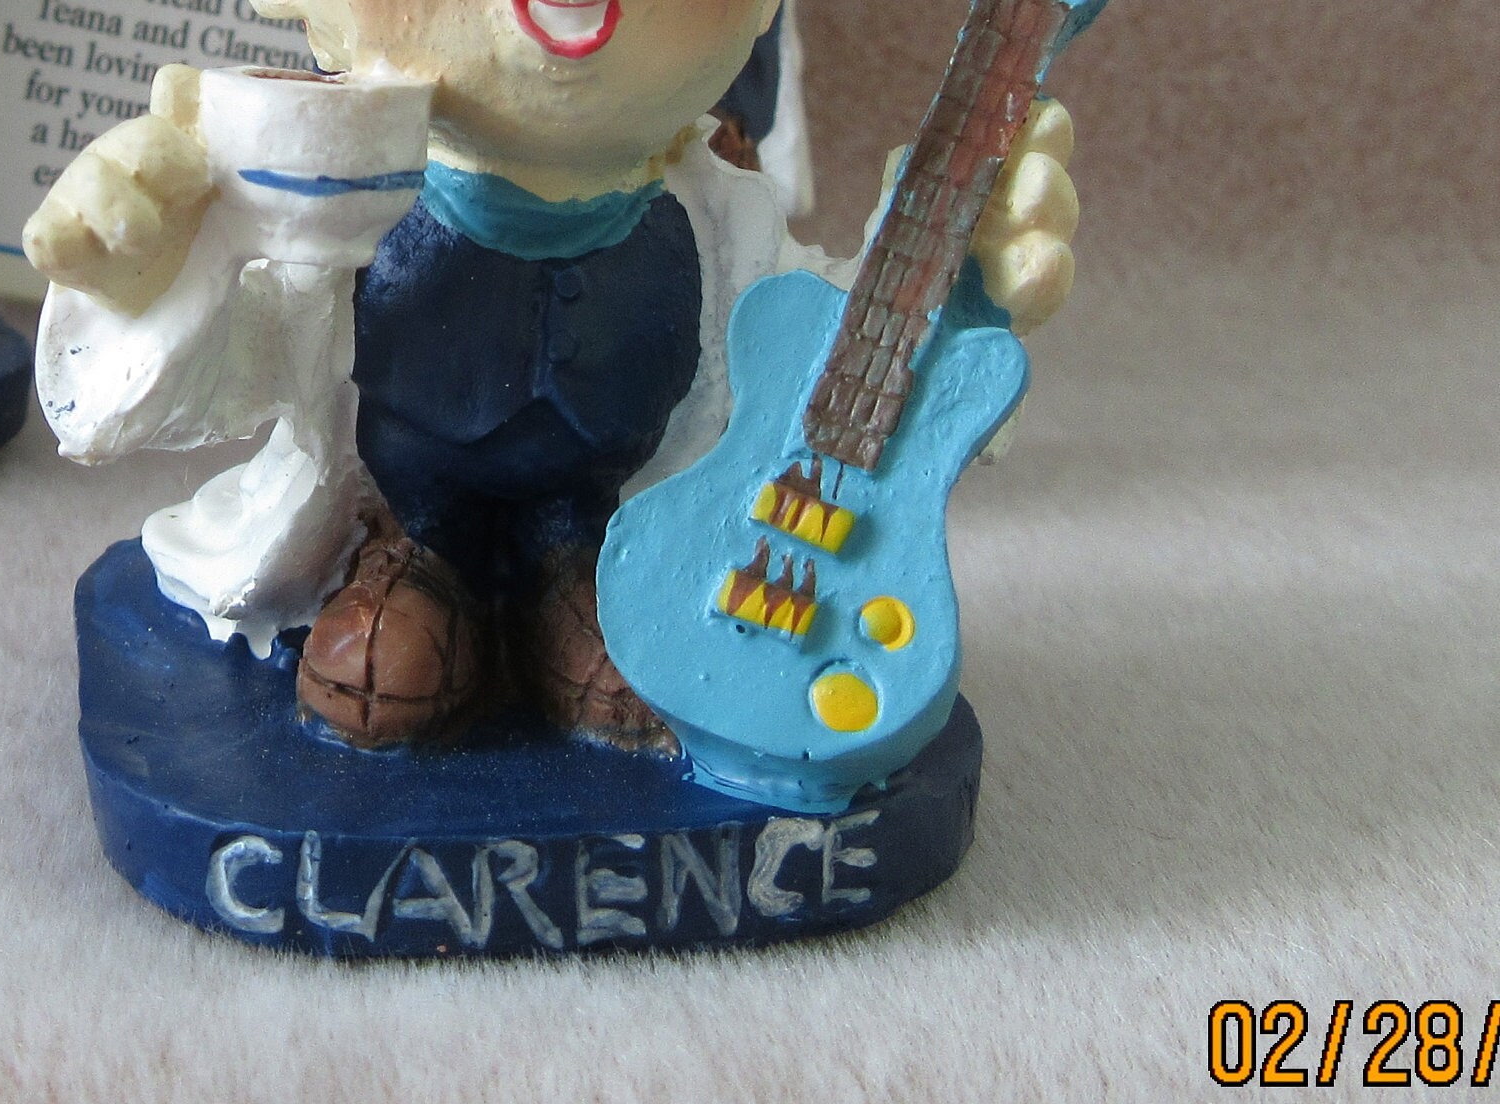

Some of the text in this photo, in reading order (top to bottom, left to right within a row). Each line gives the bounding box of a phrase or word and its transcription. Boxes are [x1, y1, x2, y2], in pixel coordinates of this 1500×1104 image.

[3, 22, 158, 84] been lovin
[133, 20, 191, 49] and
[201, 25, 315, 71] Clarenc
[25, 67, 71, 109] for
[30, 120, 49, 144] a
[205, 810, 882, 950] CLARENCE
